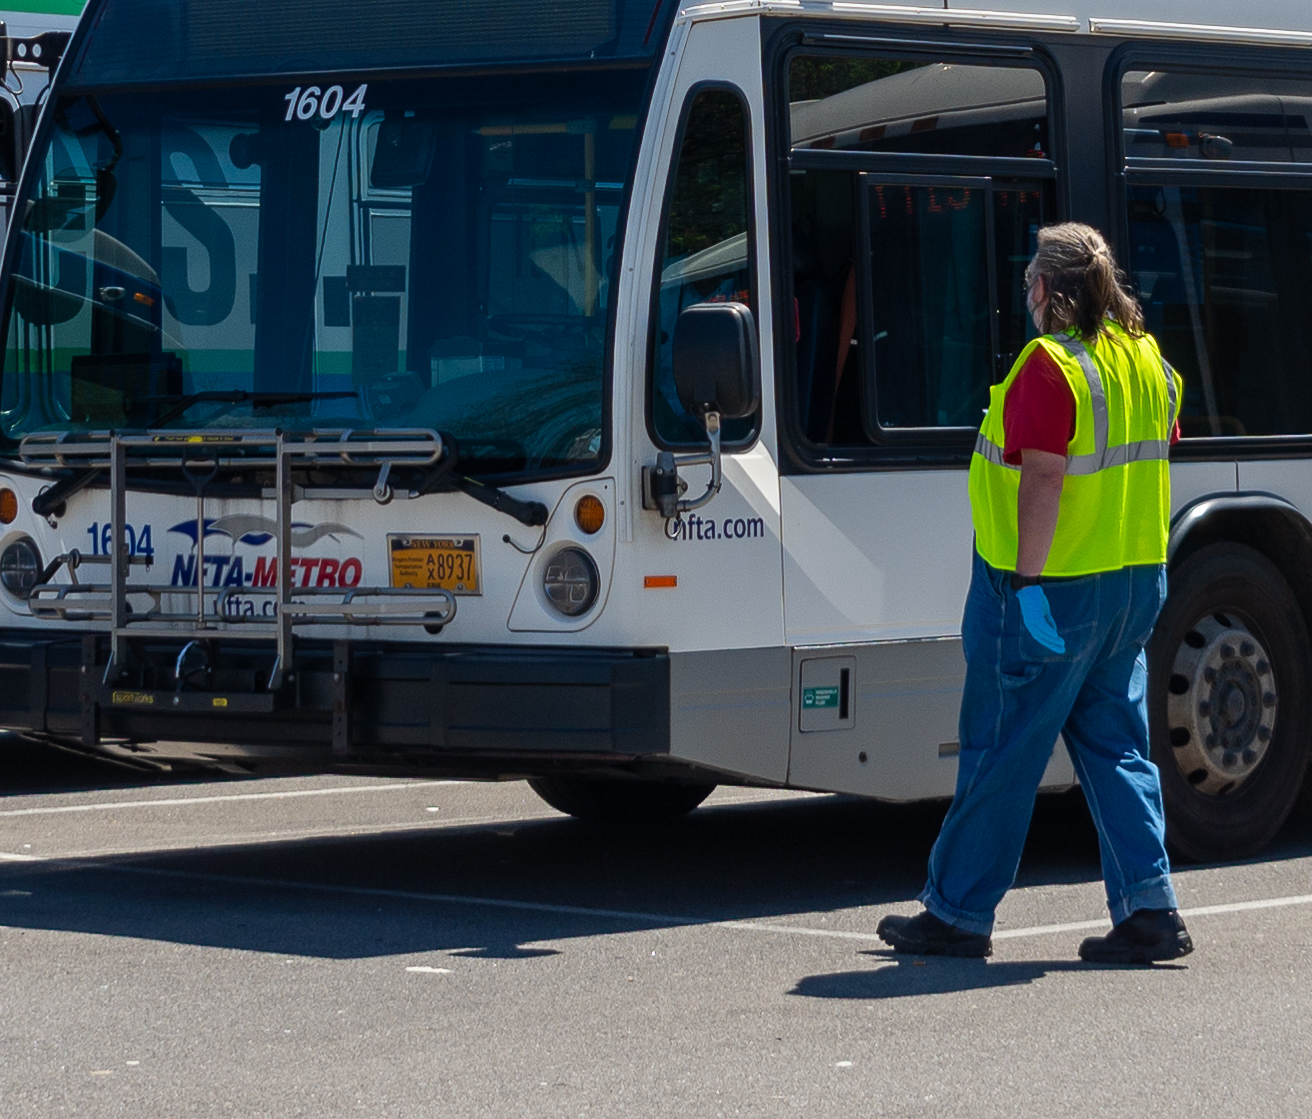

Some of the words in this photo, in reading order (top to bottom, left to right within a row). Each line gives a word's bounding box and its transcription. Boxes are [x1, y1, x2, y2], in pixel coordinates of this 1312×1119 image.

[283, 83, 368, 122] 1604
[87, 521, 155, 556] 1604
[673, 514, 764, 541] nfta.com
[411, 540, 432, 548] NEW
[432, 540, 454, 548] YORK
[437, 553, 473, 581] 8937
